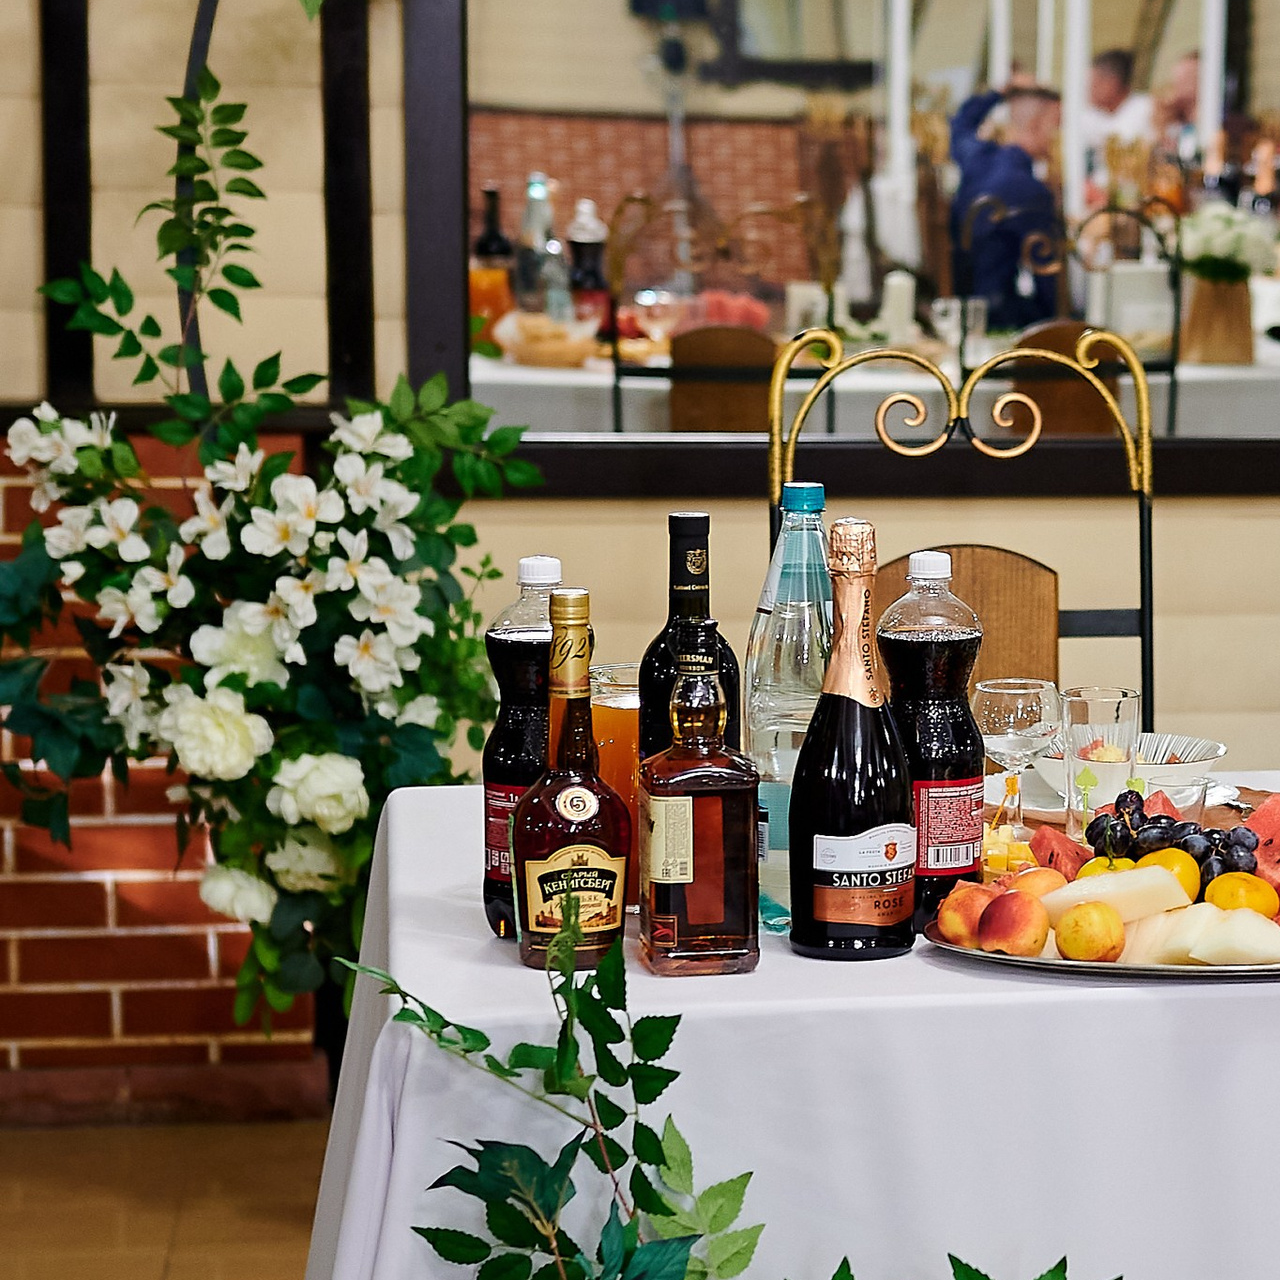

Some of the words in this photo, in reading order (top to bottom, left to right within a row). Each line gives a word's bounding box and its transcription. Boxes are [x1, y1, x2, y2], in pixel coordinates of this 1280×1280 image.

[862, 588, 872, 640] STEFANO
[862, 643, 874, 681] SANTO
[560, 871, 599, 880] САРЫЙ
[832, 872, 881, 887] SANTO
